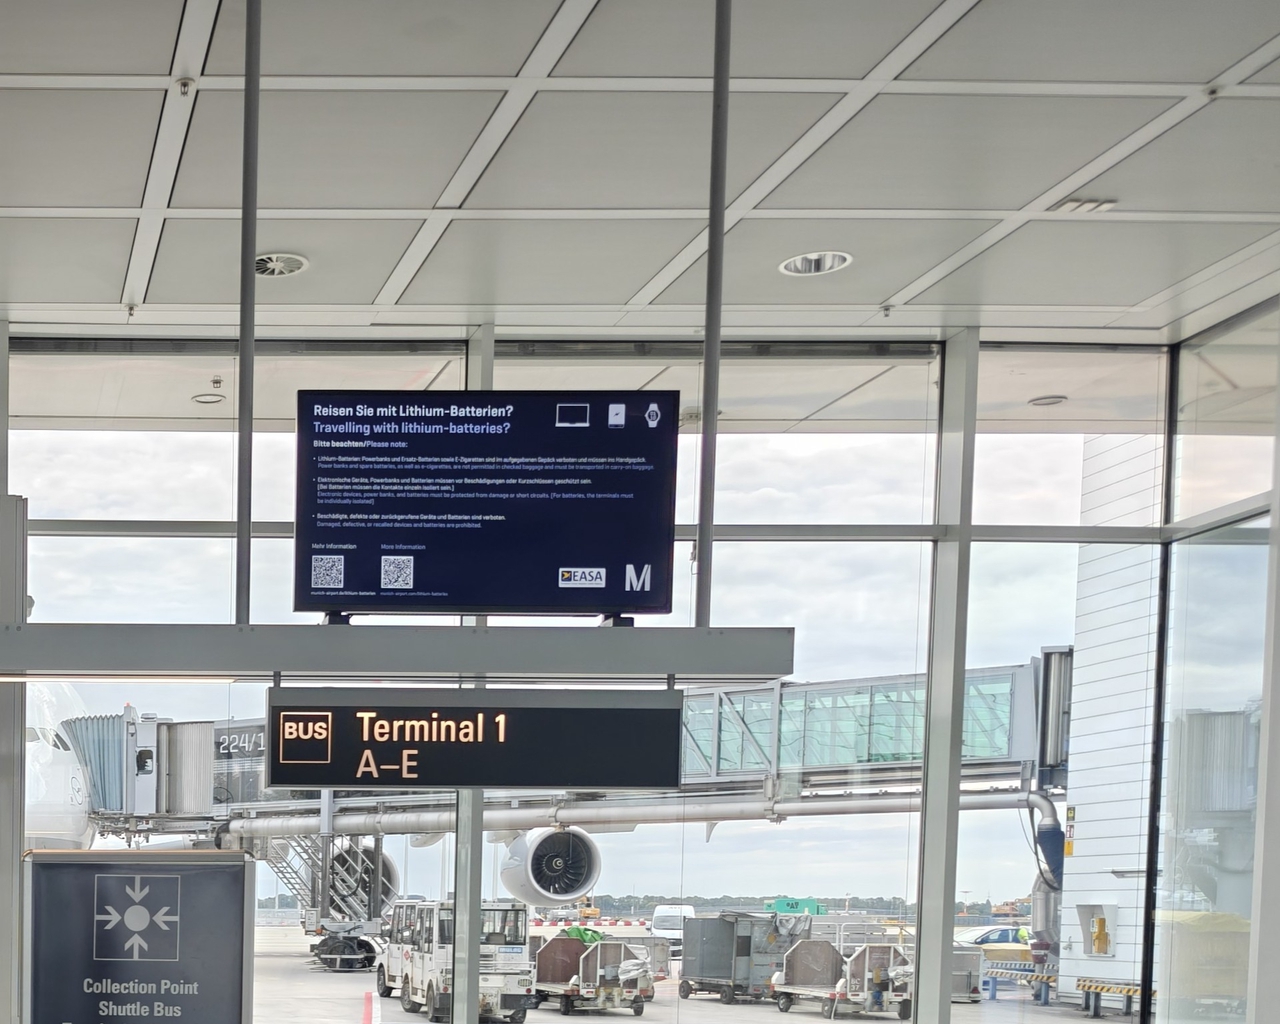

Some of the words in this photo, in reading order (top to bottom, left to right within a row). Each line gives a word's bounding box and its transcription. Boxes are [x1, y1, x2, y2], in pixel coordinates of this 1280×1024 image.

[314, 405, 354, 417] Reisen
[356, 405, 374, 417] Sie
[376, 405, 397, 417] mit
[400, 405, 514, 417] Lithium-Batterien?
[314, 422, 370, 436] Travelling
[373, 422, 398, 433] with
[401, 422, 511, 434] lithium-batteries?
[573, 571, 602, 581] EASA
[284, 721, 328, 740] BUS
[356, 712, 484, 743] Terminal
[494, 714, 506, 743] 1
[220, 732, 266, 753] 224/1
[84, 978, 156, 994] Collection
[161, 979, 198, 994] Point
[99, 1002, 150, 1016] Shuttle
[154, 1002, 182, 1016] Bus
